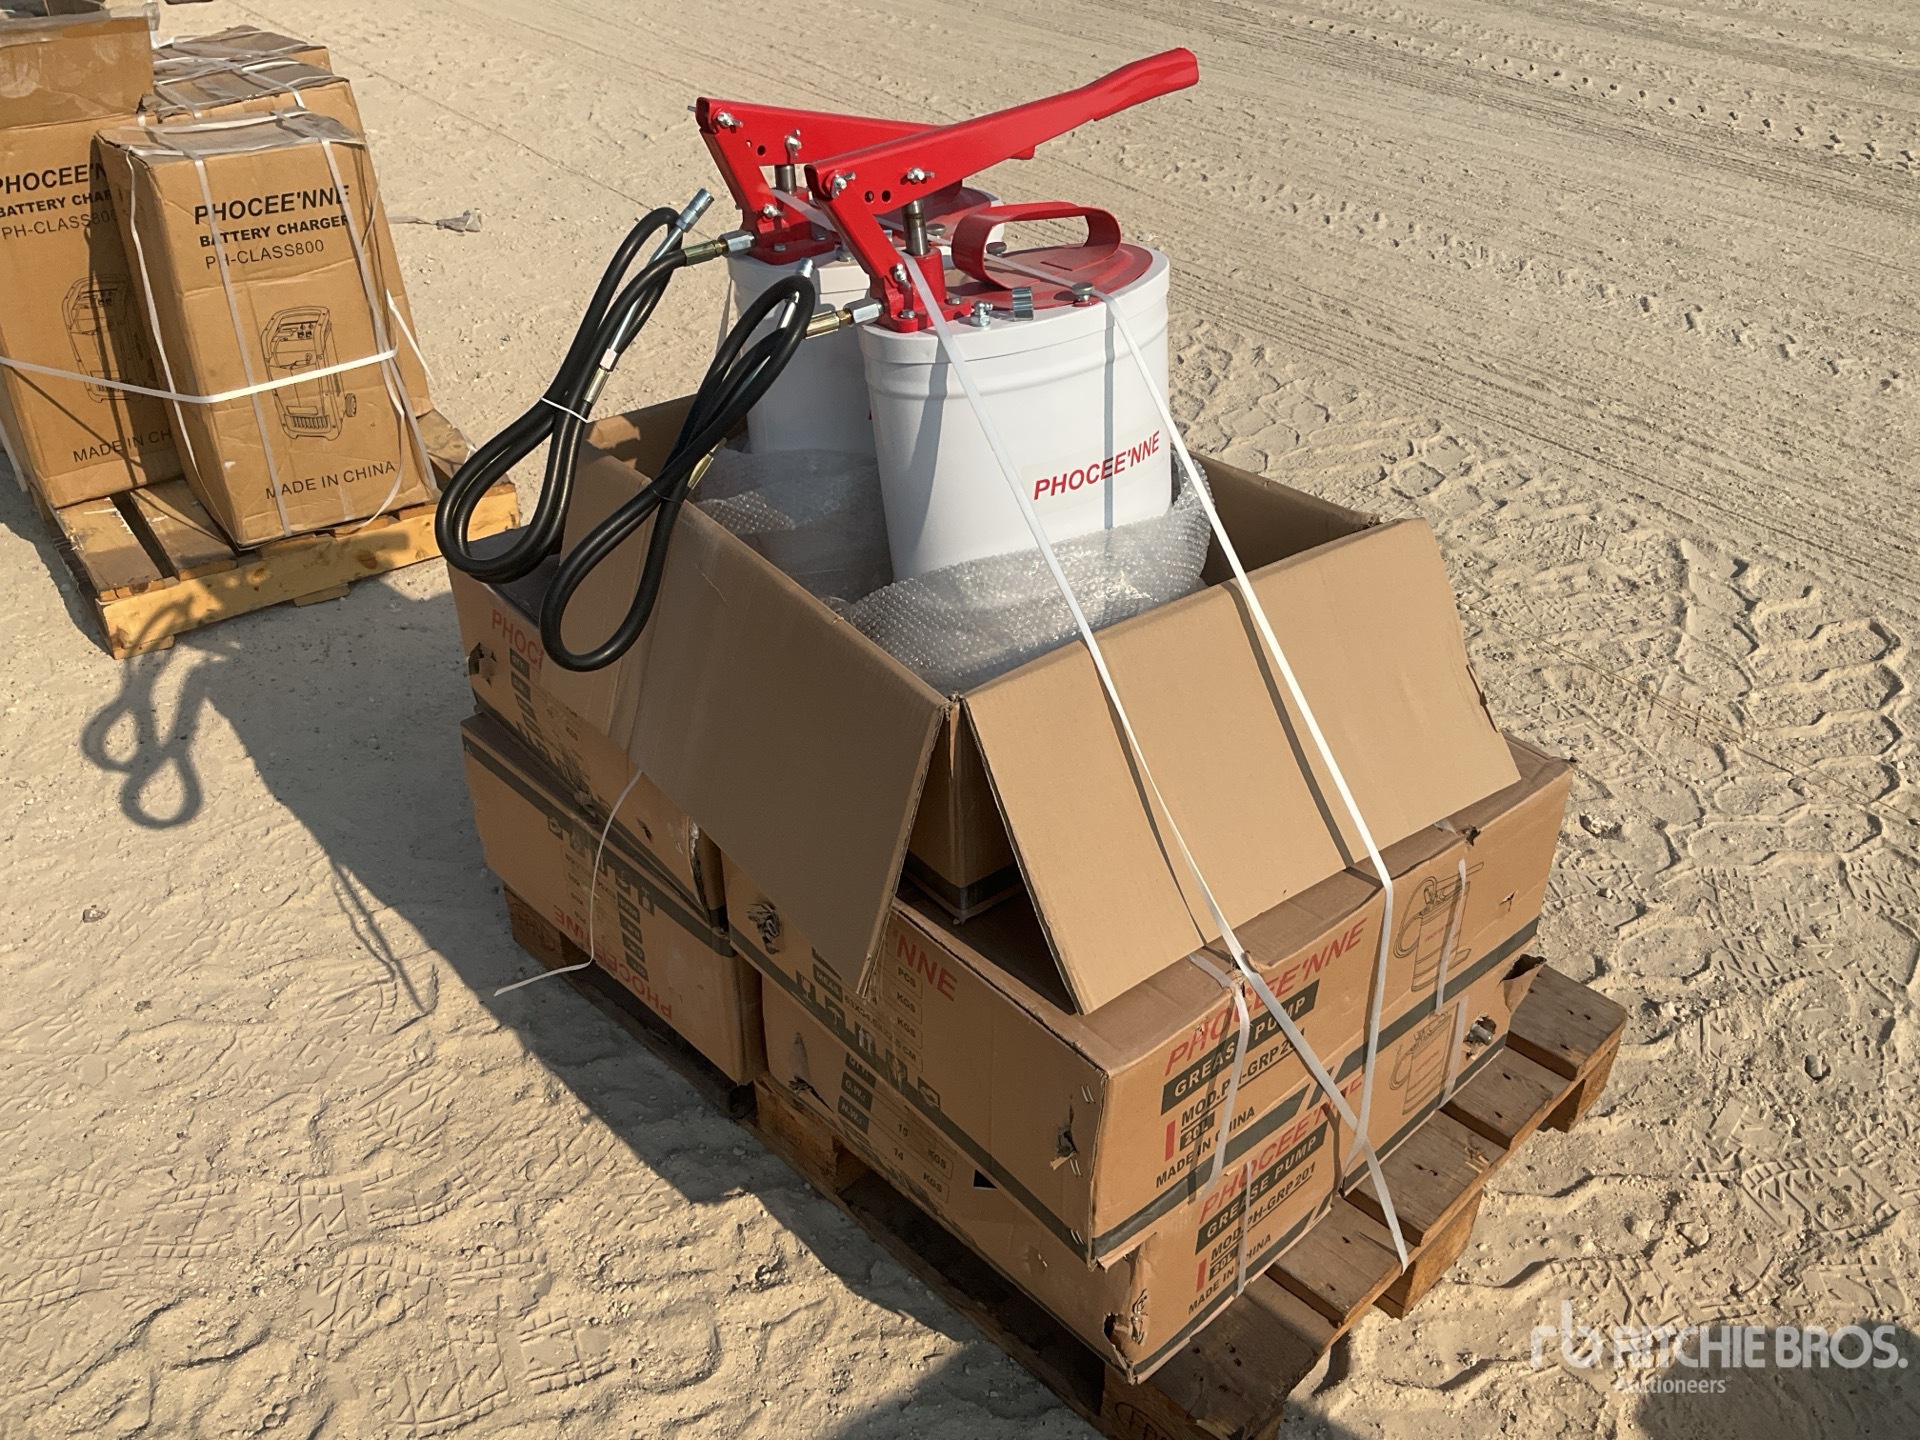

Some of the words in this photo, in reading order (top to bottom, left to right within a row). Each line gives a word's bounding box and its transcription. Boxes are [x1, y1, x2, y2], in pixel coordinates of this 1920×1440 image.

[0, 197, 66, 217] BATTERY
[73, 440, 122, 463] MADE
[125, 436, 145, 450] IN
[322, 473, 339, 488] IN
[343, 460, 396, 484] CHINA
[1034, 430, 1160, 501] PHOCEE'NNE
[1174, 1042, 1237, 1097] GREAS
[1184, 1121, 1210, 1144] 20L
[927, 1148, 947, 1170] KGS
[1156, 1151, 1194, 1188] MADE
[1197, 1140, 1211, 1157] IN
[922, 1172, 943, 1193] KGS
[1207, 1177, 1269, 1238] GREASE
[1274, 1136, 1317, 1179] PUMP
[1189, 1283, 1220, 1314] MADE
[1223, 1267, 1235, 1283] IN
